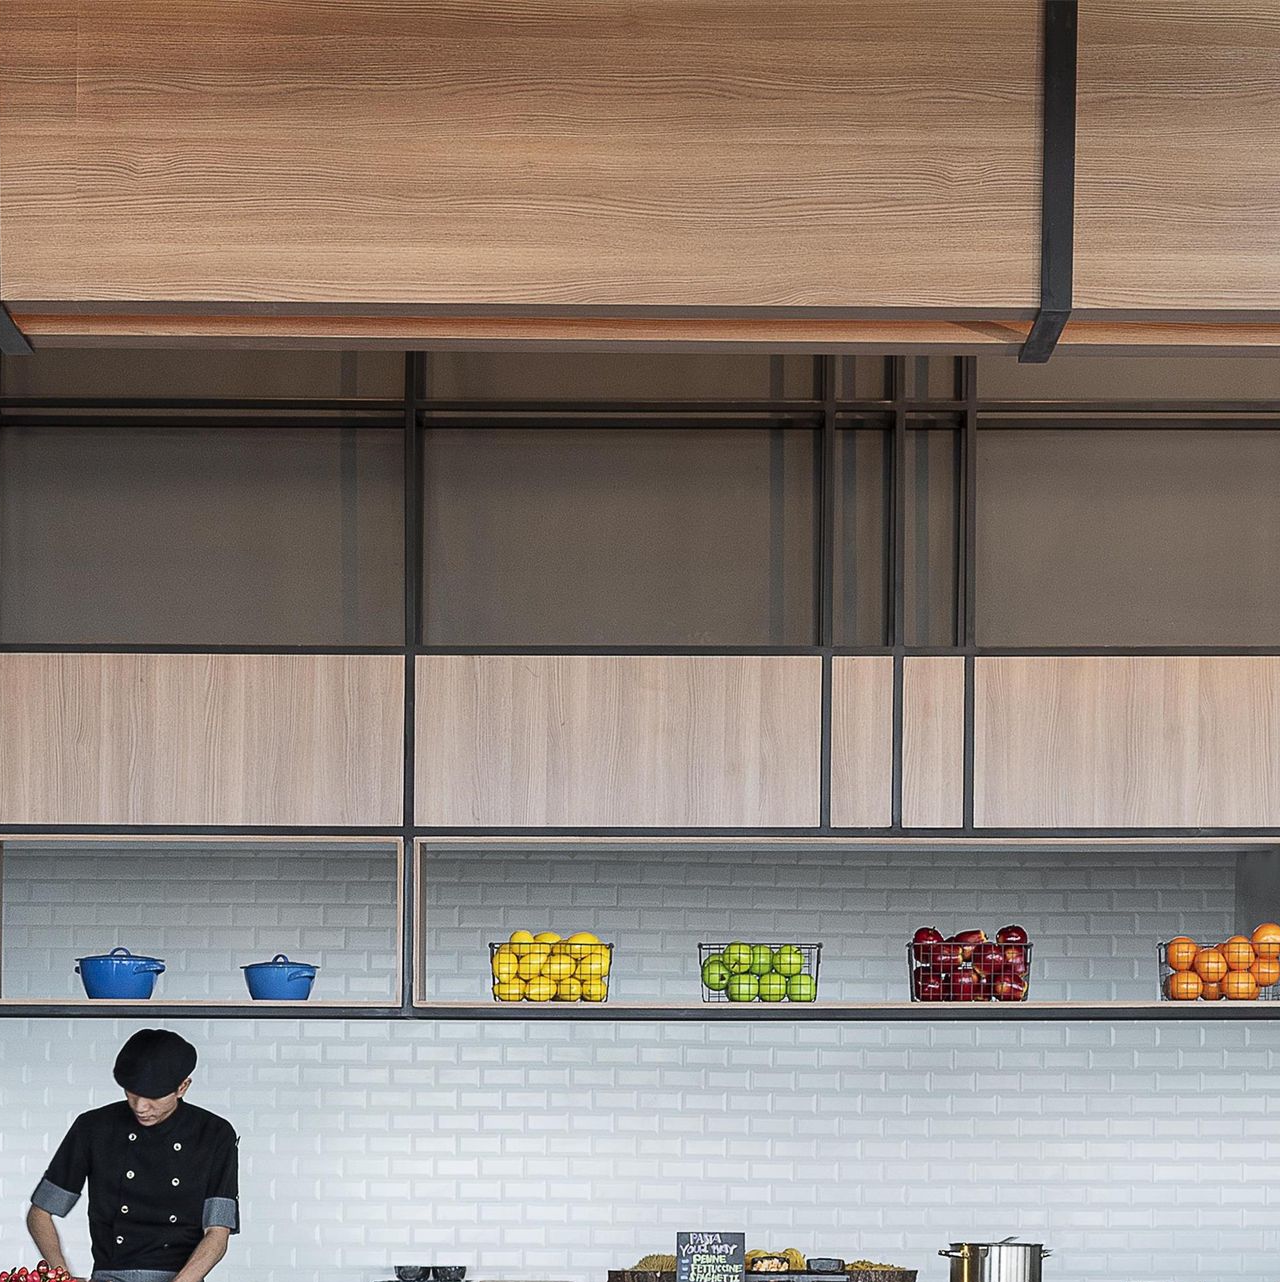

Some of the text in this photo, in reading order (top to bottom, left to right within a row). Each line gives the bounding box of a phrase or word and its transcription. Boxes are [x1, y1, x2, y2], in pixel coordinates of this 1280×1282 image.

[689, 1233, 721, 1245] PASTA
[680, 1243, 708, 1257] YOUR
[693, 1254, 726, 1264] PENNE
[689, 1273, 740, 1282] SPAGHETTI
